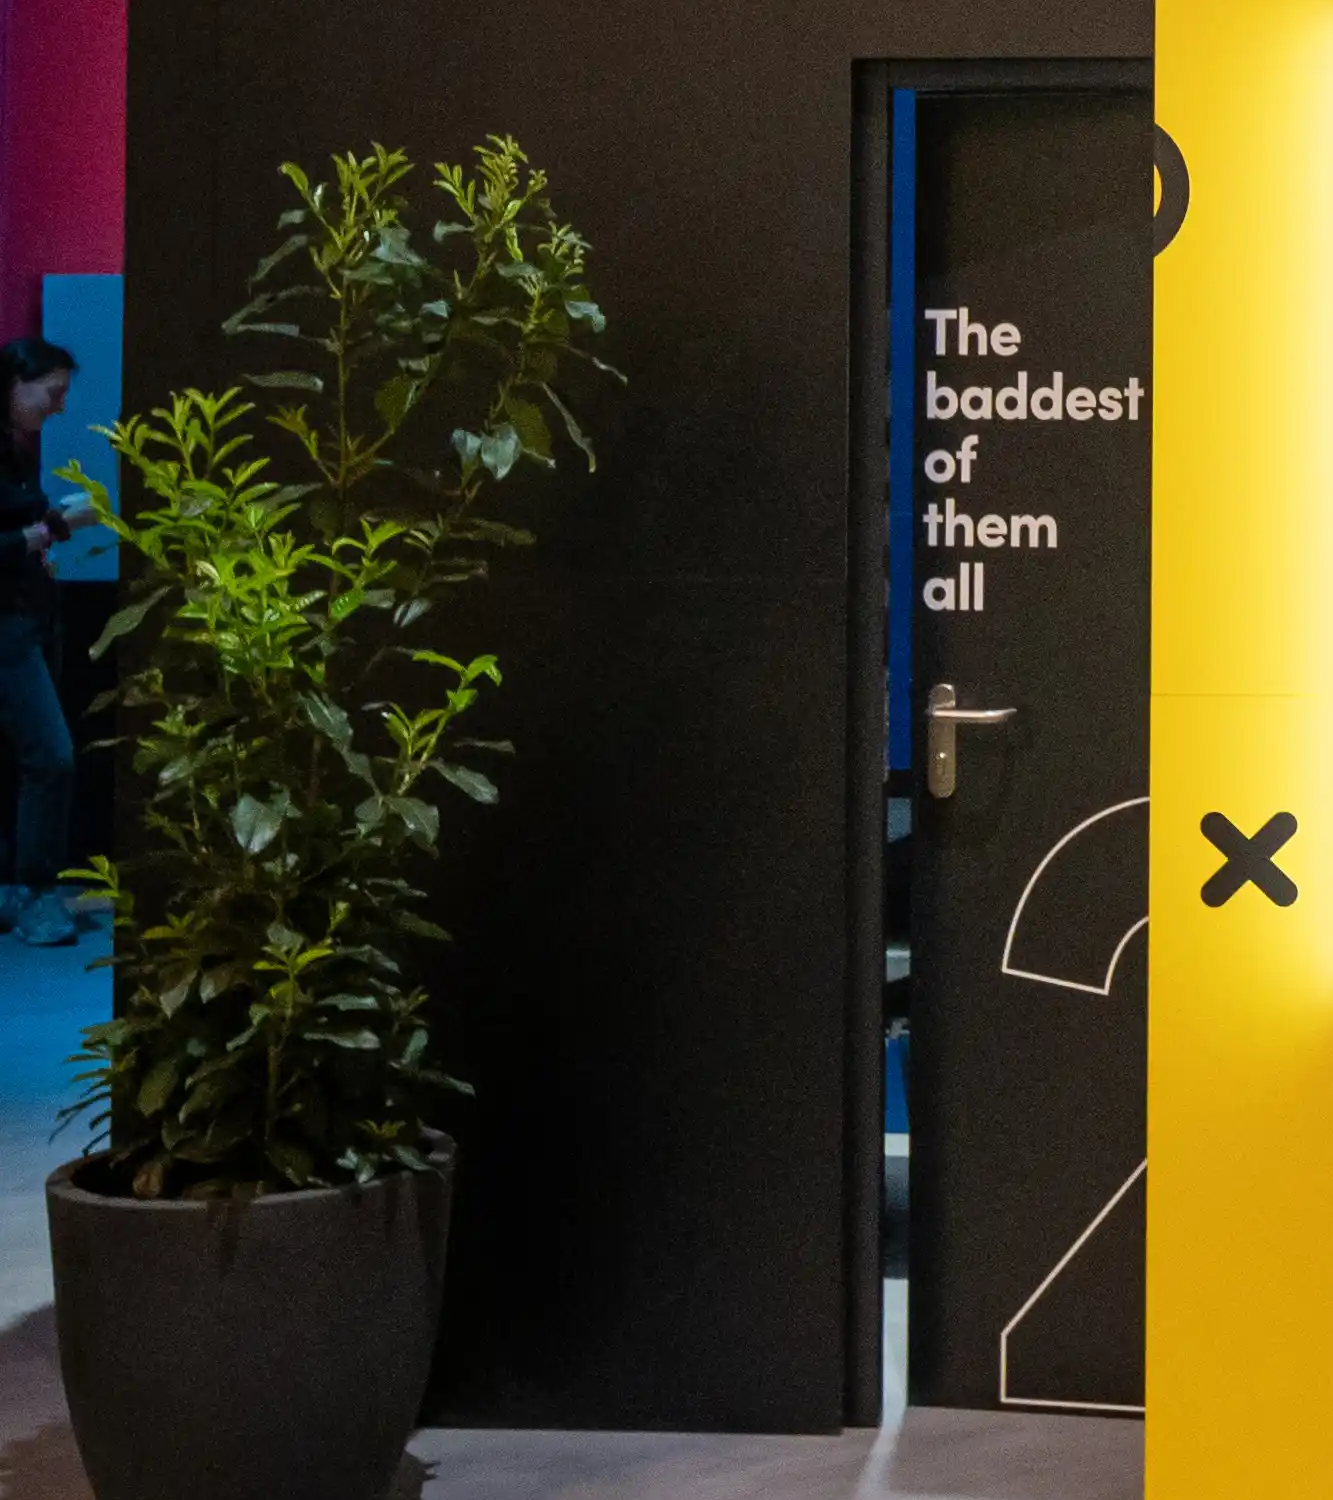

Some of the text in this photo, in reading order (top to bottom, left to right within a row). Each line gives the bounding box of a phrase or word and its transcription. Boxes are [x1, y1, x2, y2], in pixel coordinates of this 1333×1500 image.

[925, 307, 1021, 356] The
[927, 371, 1144, 420] baddest
[925, 435, 979, 483] of
[923, 498, 1057, 548] them
[923, 562, 983, 611] all
